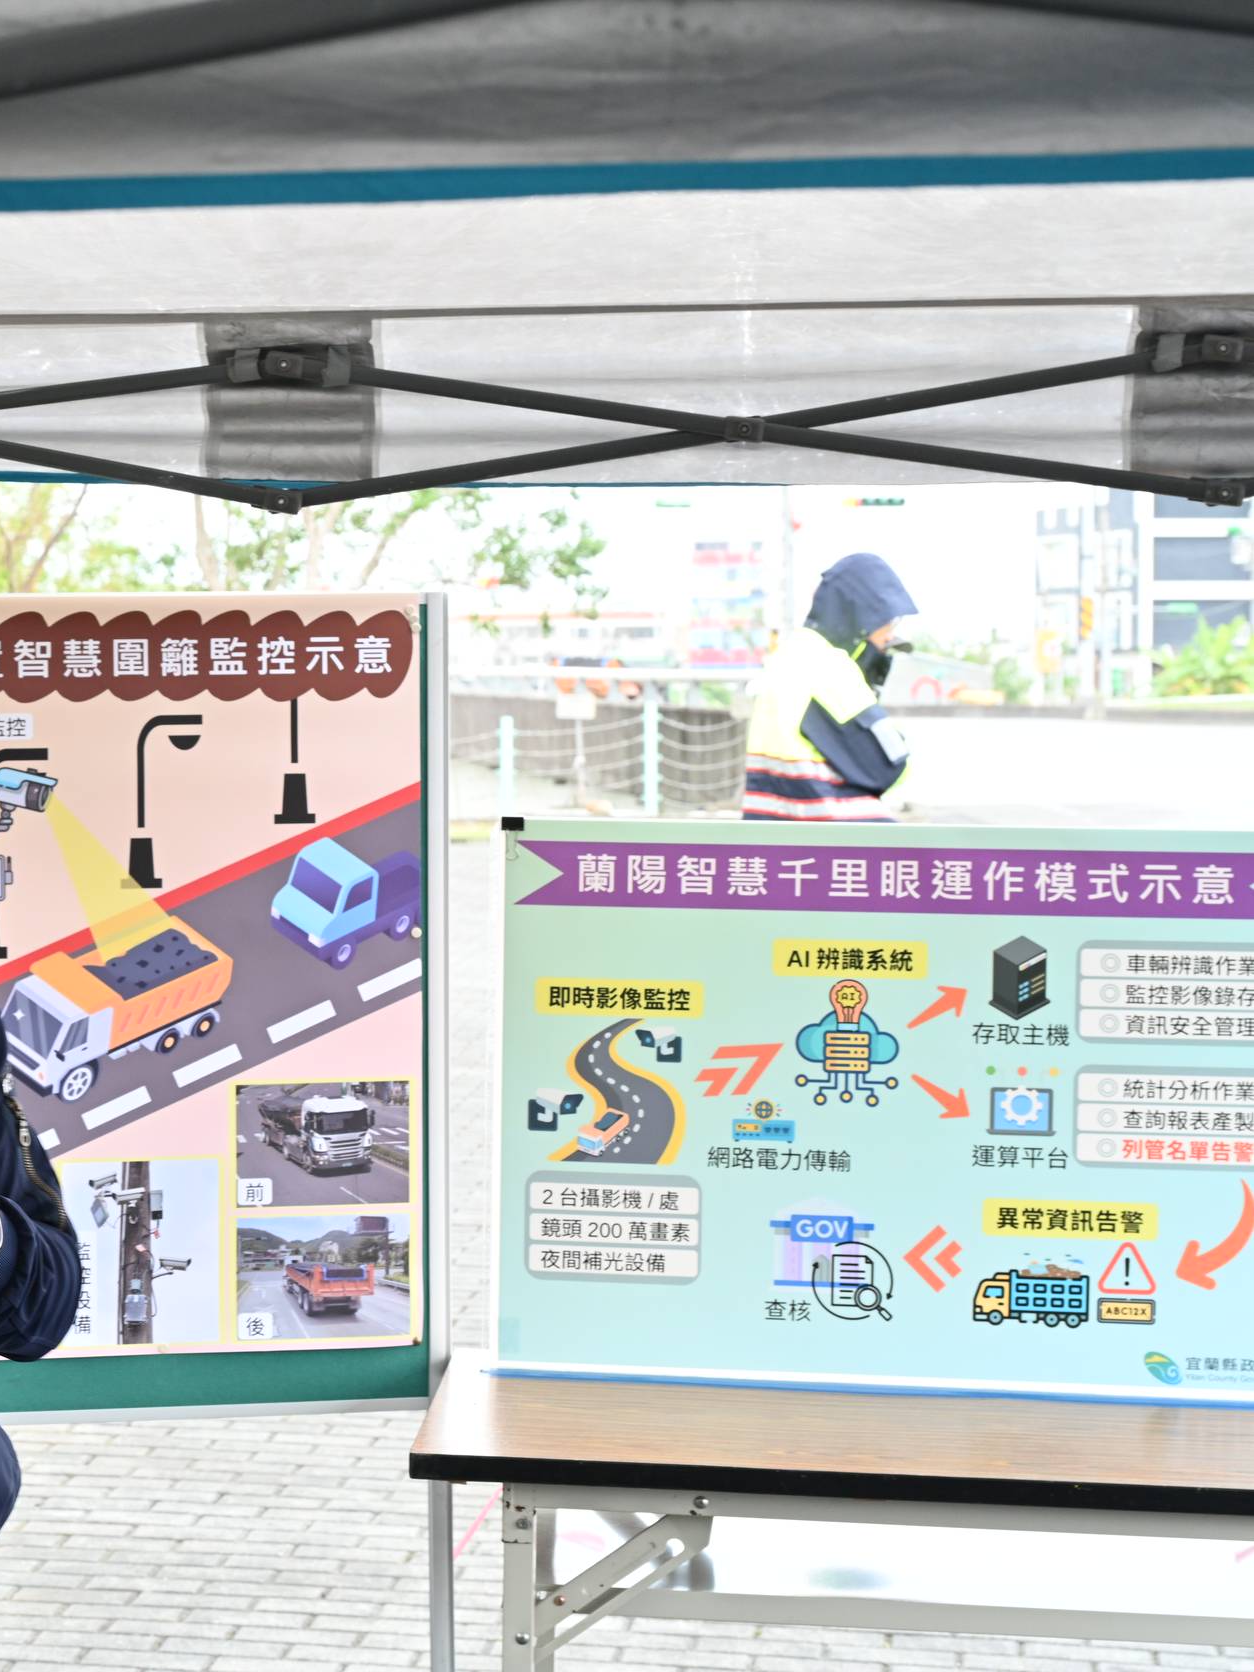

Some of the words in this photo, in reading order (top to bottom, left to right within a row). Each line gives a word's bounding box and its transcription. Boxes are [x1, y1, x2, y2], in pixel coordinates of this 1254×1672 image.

[576, 854, 1235, 905] 蘭陽智慧千里眼運作模式示意
[787, 950, 810, 969] AI
[817, 947, 914, 972] 辨識系統
[1126, 954, 1254, 976] 車輛辨識作業
[548, 986, 691, 1011] 即時影像監控
[841, 992, 856, 1001] AI
[1126, 984, 1254, 1007] 監控影像錄存
[972, 1022, 1070, 1047] 存取主機
[1125, 1014, 1254, 1037] 資訊安全管理
[1123, 1079, 1254, 1101] 統計分析作業
[1123, 1110, 1254, 1132] 查詢報表產製
[707, 1147, 852, 1172] 網路電力傳輸
[972, 1144, 1069, 1169] 運算平台
[1122, 1139, 1254, 1162] 列管名單告警
[246, 1183, 264, 1203] 前
[542, 1189, 554, 1205] 2
[560, 1187, 642, 1210] 台攝影機
[658, 1191, 680, 1211] 處
[541, 1218, 582, 1238] 鏡頭
[588, 1222, 623, 1239] 200
[628, 1220, 691, 1243] 萬畫素
[795, 1219, 848, 1239] GOV
[996, 1207, 1144, 1234] 異常資訊告警
[540, 1250, 666, 1273] 夜間補光設備
[764, 1300, 812, 1322] 查核
[1105, 1305, 1148, 1317] ABC12X
[246, 1316, 265, 1337] 後
